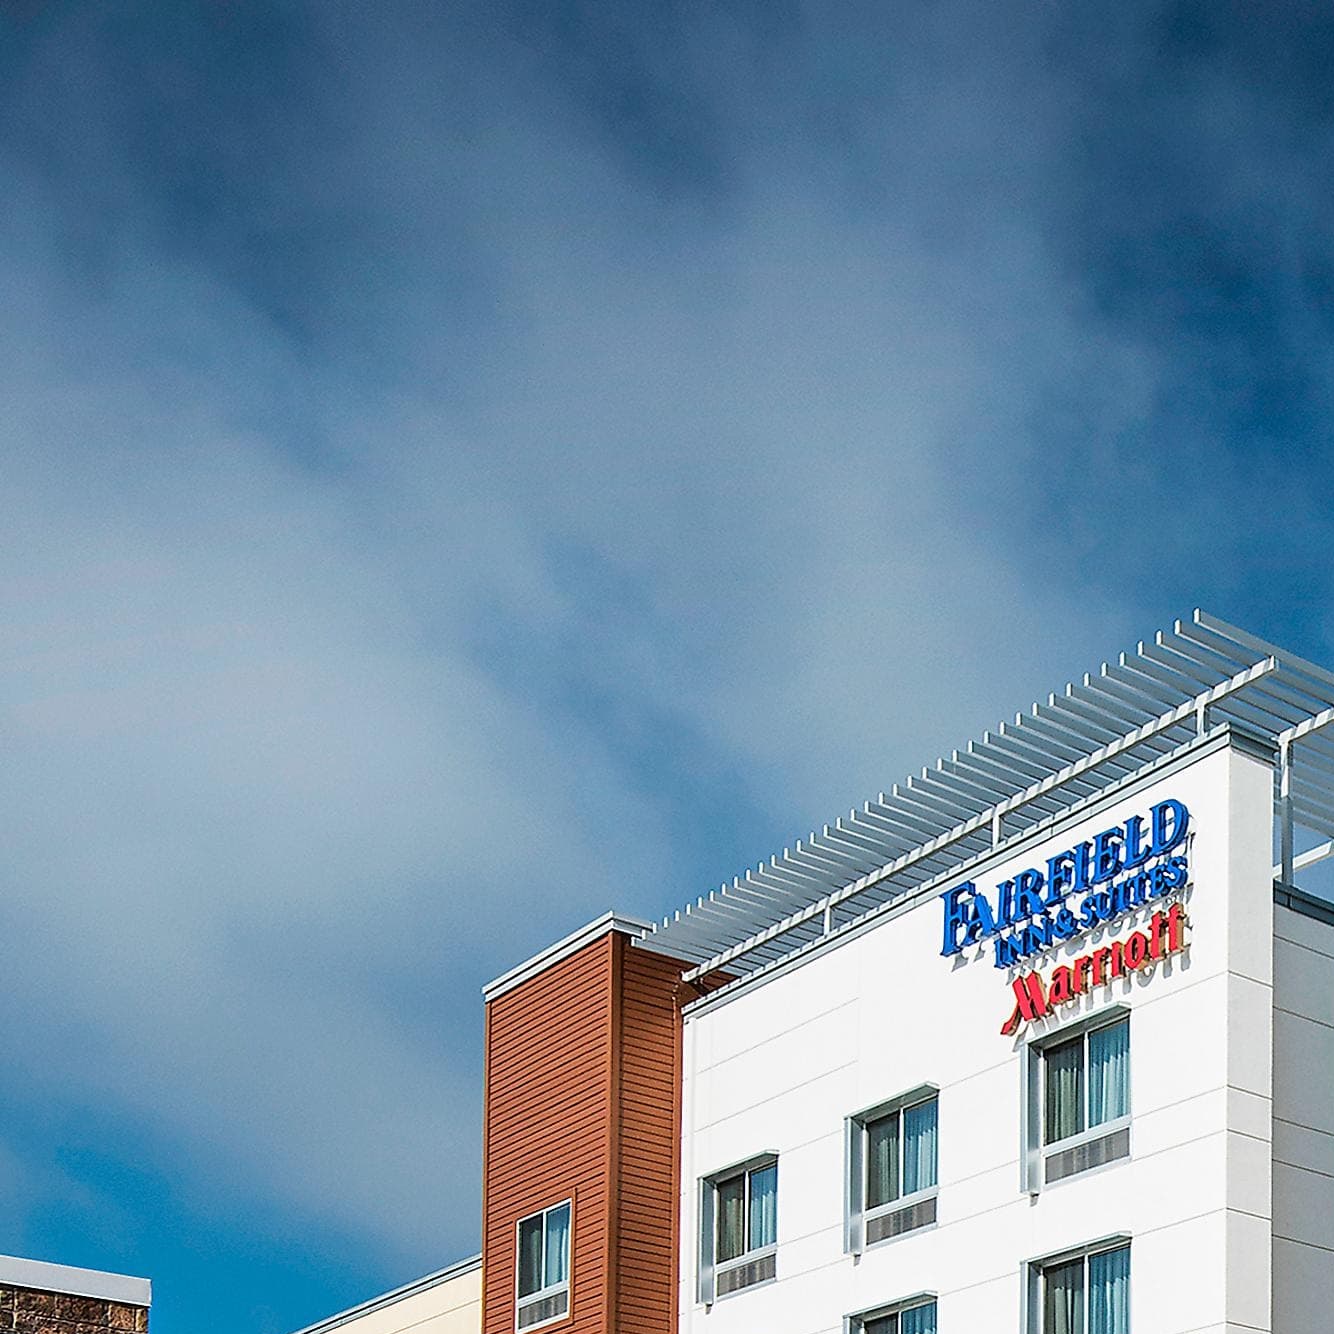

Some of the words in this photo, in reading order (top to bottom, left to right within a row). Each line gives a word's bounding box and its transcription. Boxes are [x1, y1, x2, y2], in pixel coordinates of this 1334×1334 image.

[939, 799, 1190, 957] FAIRFIELD
[994, 914, 1056, 969] INN
[1051, 907, 1082, 942] &
[1080, 855, 1189, 929] SUITES
[1000, 901, 1186, 1036] Marriott
